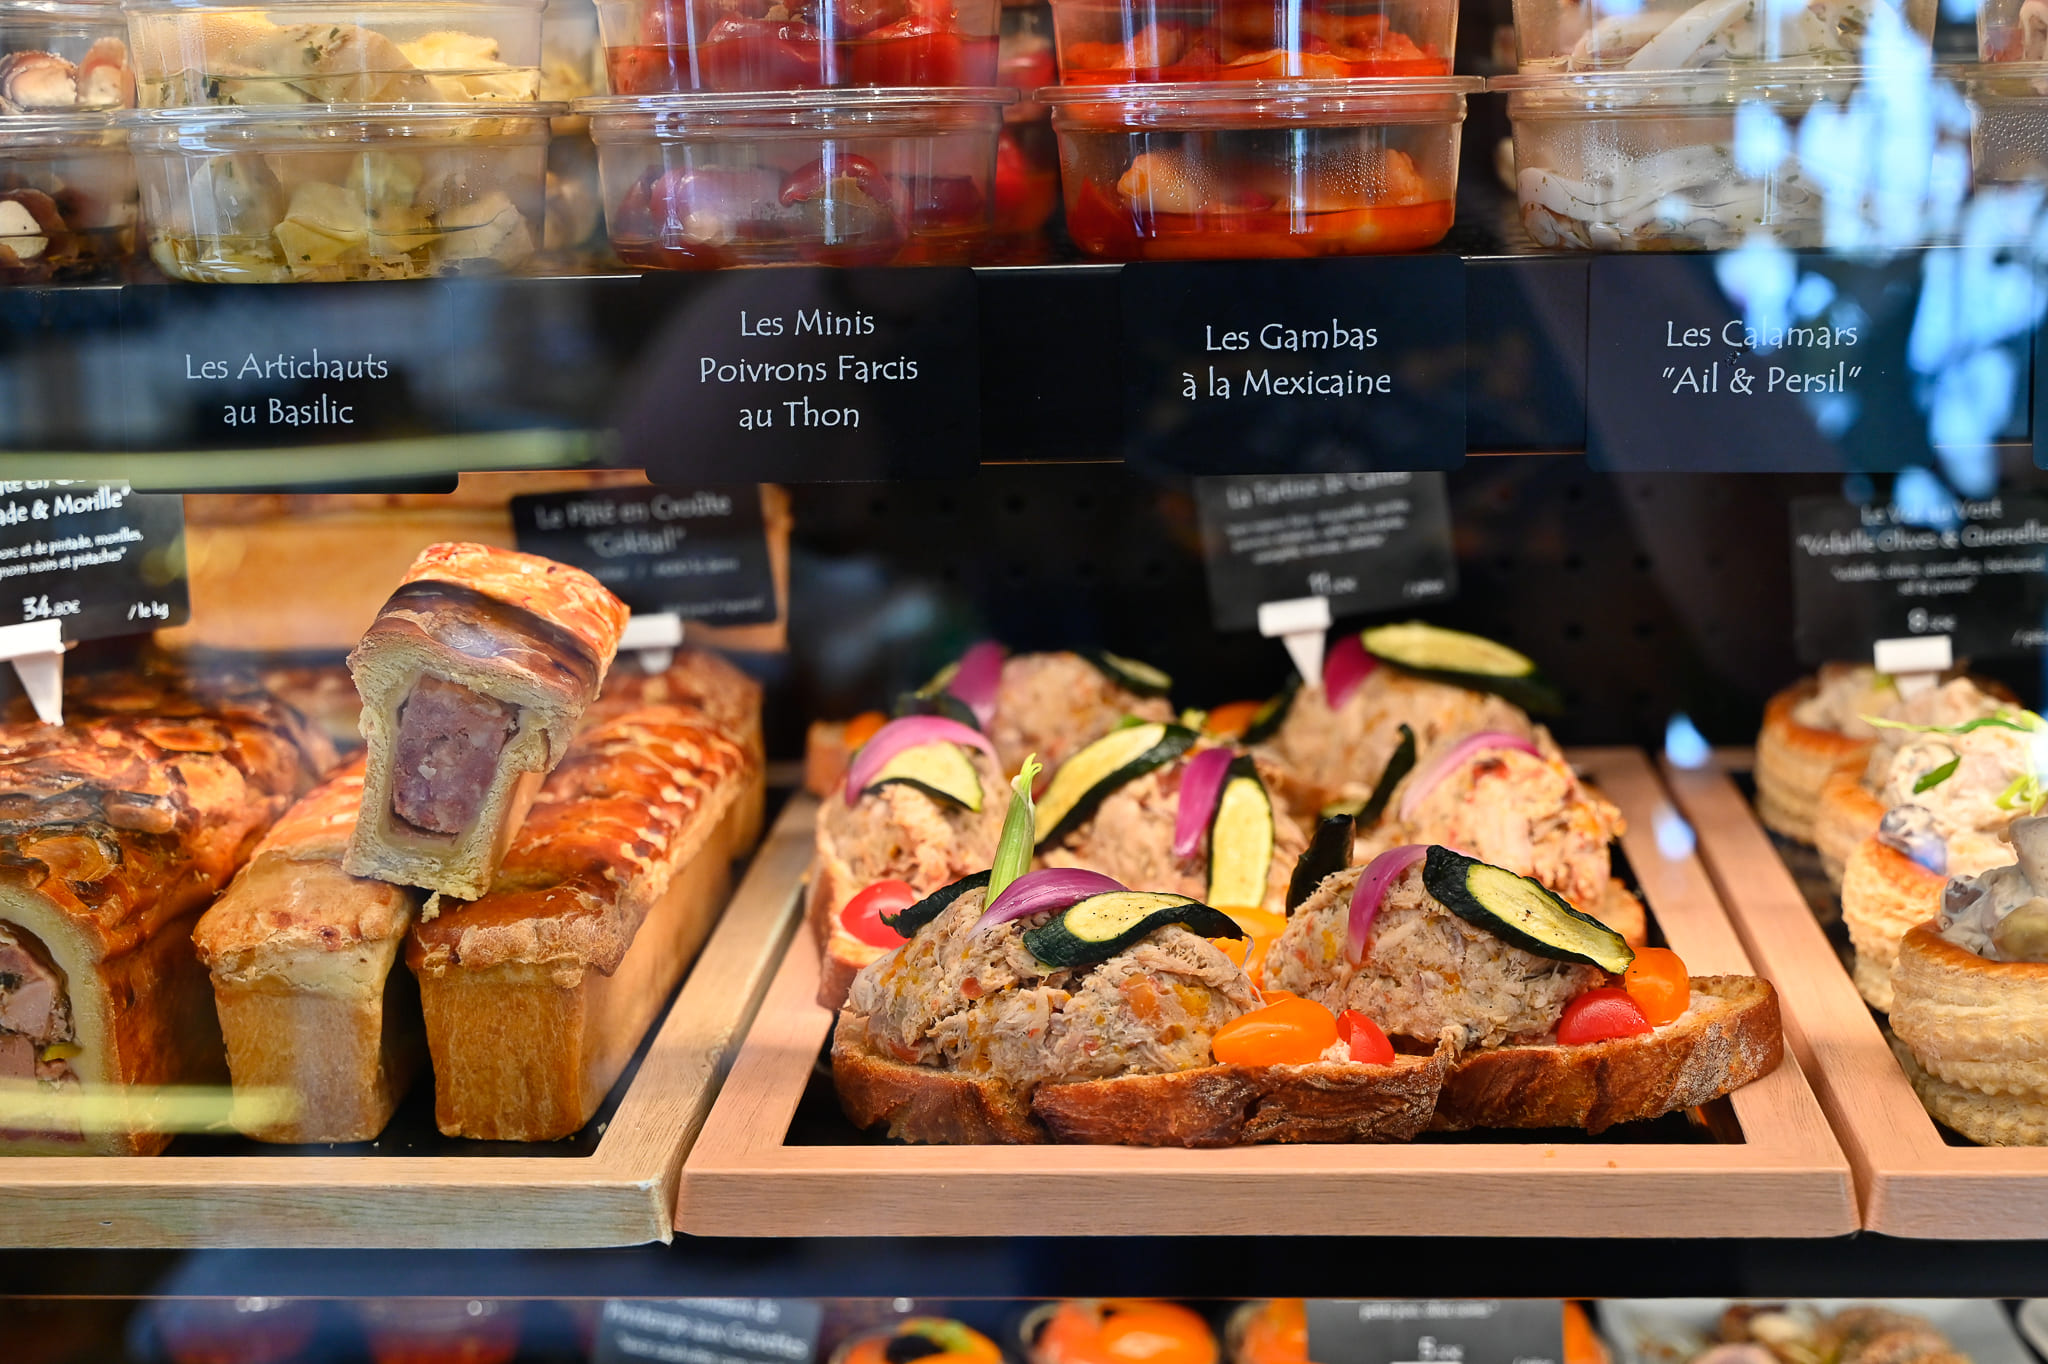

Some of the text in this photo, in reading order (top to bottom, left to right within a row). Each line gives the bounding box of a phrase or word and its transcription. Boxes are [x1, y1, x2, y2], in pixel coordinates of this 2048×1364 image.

[740, 308, 876, 337] Les Minis
[1206, 318, 1379, 352] Les Gambas
[1666, 315, 1859, 349] Les Calamars
[185, 348, 389, 382] Les Artichauts
[700, 355, 919, 384] Poivrons Farcis
[1729, 367, 1756, 395] &
[1182, 365, 1392, 400] à la Mexicaine
[223, 393, 355, 427] au Basilic
[739, 395, 861, 431] au Thon
[32, 499, 50, 520] &
